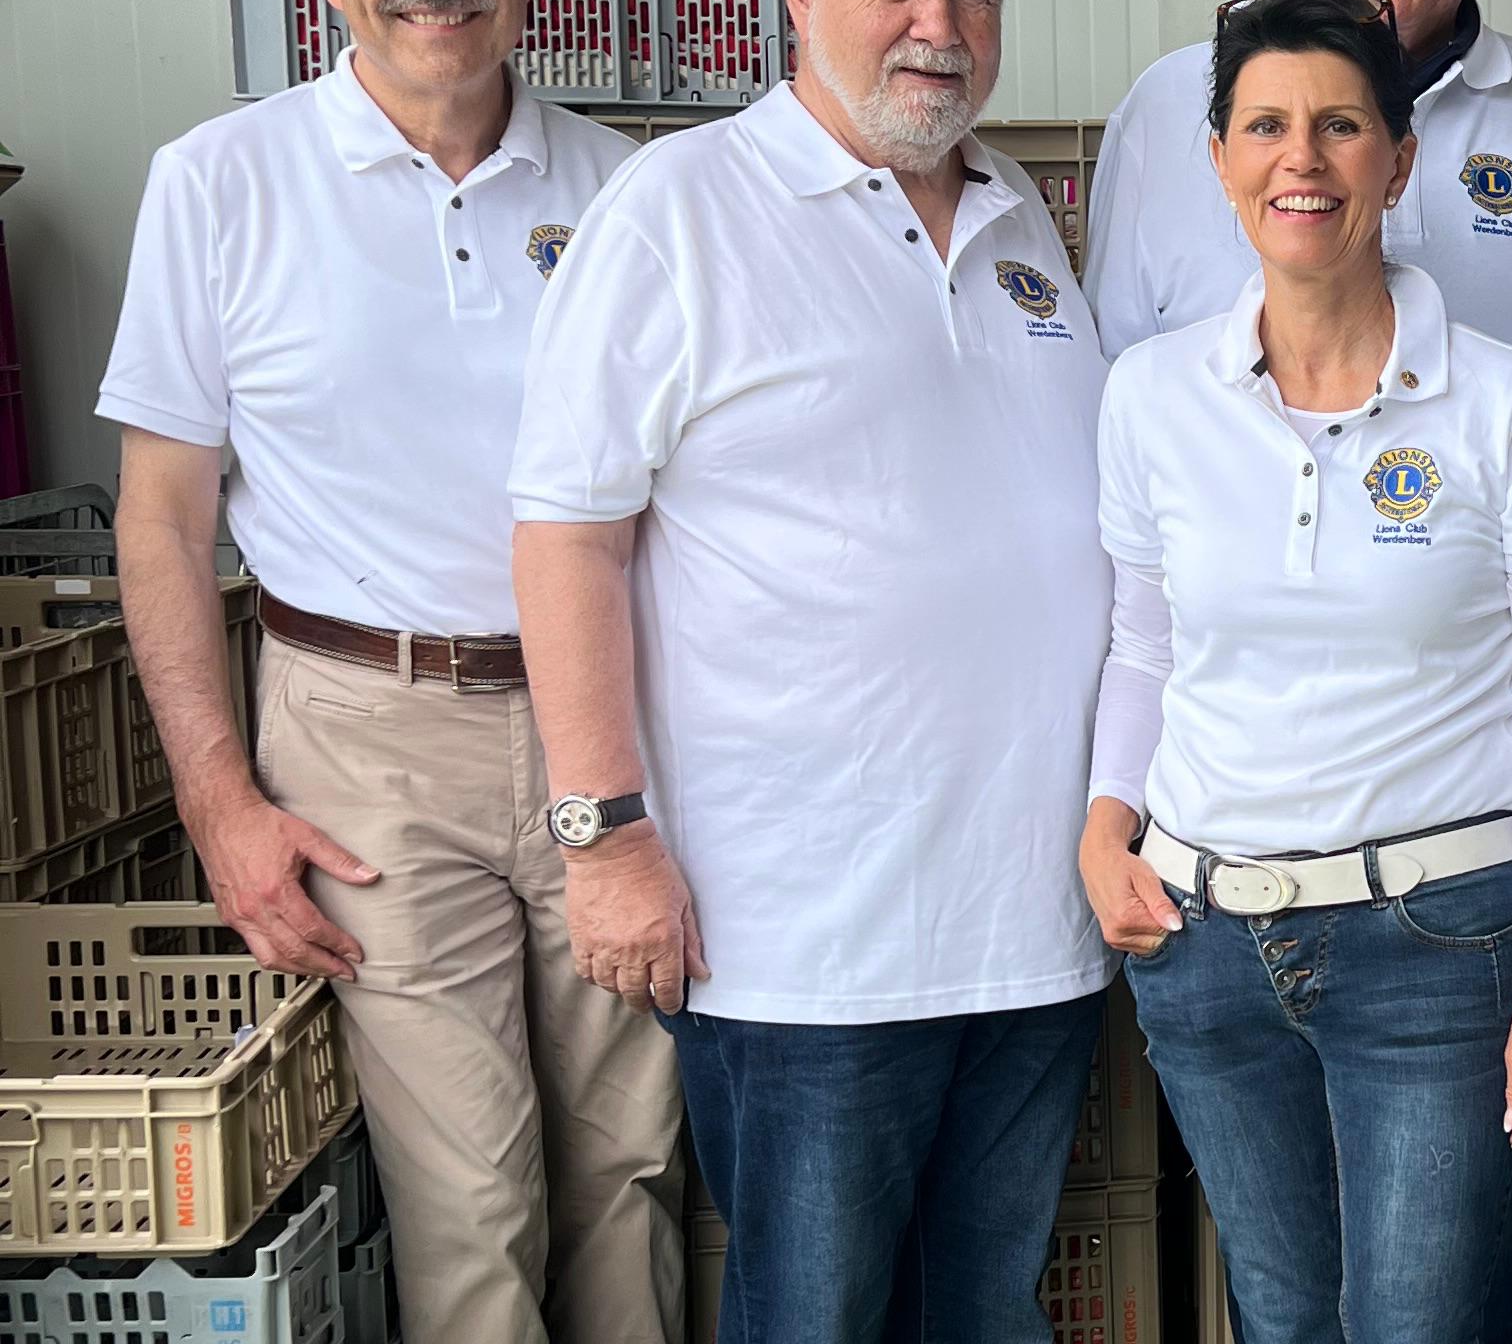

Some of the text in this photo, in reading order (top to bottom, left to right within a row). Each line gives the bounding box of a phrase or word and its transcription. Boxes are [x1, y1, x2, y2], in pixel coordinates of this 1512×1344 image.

[1486, 171, 1505, 193] L
[1475, 215, 1498, 226] Lions
[1016, 275, 1040, 296] L
[1383, 450, 1430, 466] LIONS
[1395, 470, 1415, 495] L
[1376, 523, 1428, 534] Lions Club
[1373, 534, 1432, 546] Werdenberg
